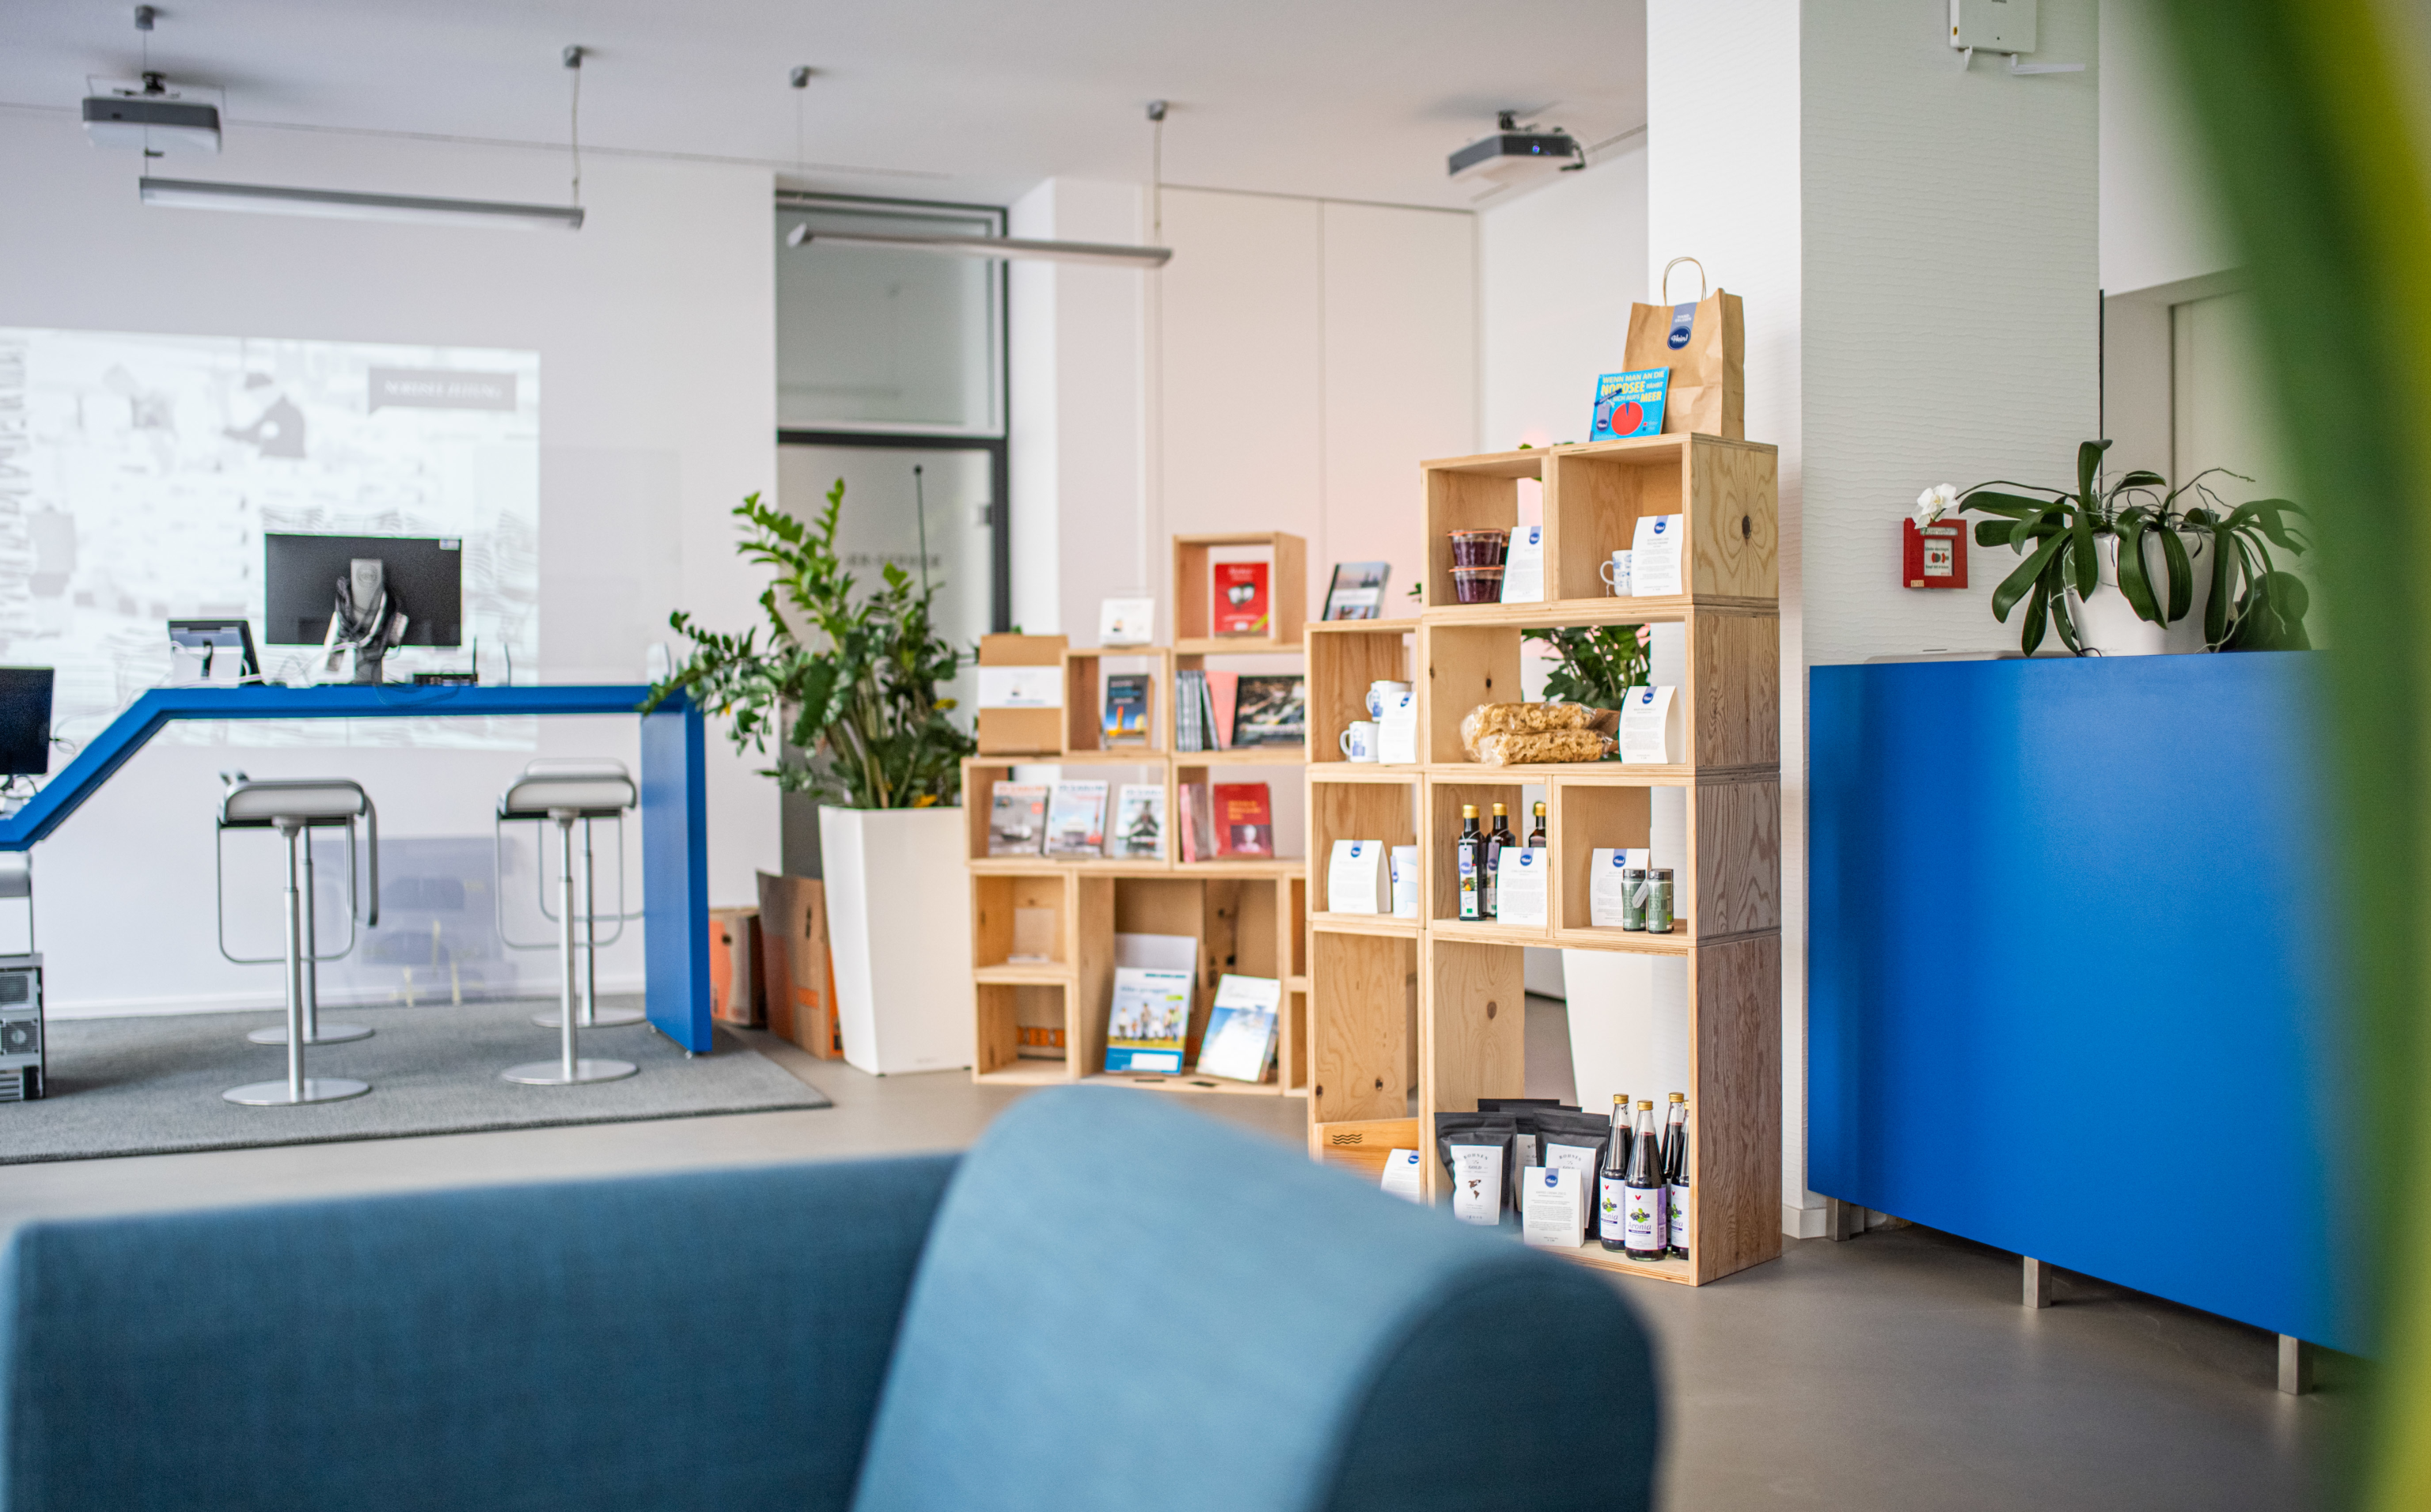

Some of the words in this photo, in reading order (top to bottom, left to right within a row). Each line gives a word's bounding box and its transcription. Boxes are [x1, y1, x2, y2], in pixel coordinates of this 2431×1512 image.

[1625, 373, 1641, 382] MAN
[1601, 381, 1645, 396] NORDSEE
[1640, 391, 1662, 403] MEER
[1600, 1212, 1618, 1221] ronia
[1628, 1222, 1652, 1230] Aronia
